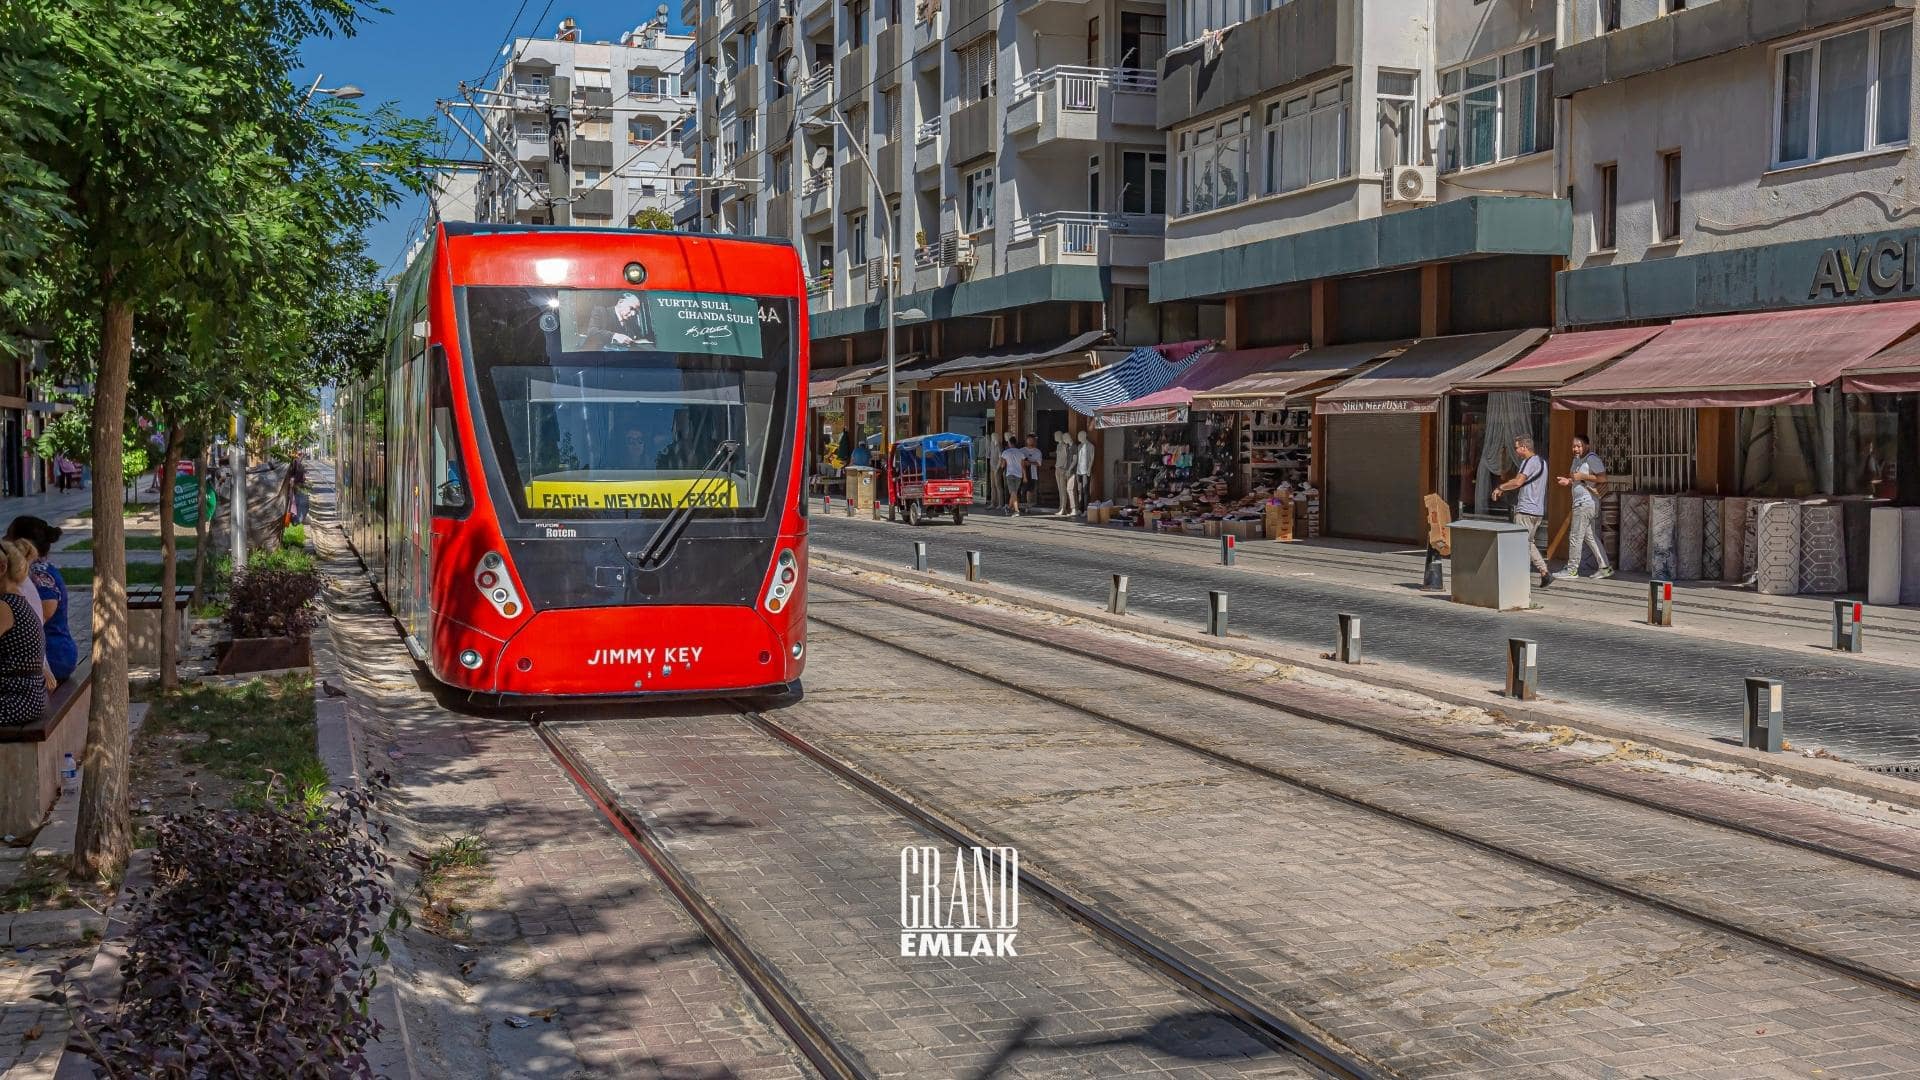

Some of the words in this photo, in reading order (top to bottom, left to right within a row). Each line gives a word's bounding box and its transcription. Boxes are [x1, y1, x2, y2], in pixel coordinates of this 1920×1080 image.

[657, 298, 700, 308] YURTTA
[701, 300, 732, 311] SULH,
[678, 308, 725, 321] CİHANDA
[727, 314, 754, 325] SULH
[954, 377, 1028, 403] HANGAR
[603, 493, 672, 508] MEYDAN
[546, 528, 577, 538] Rotem
[587, 648, 656, 665] JIMMY
[664, 646, 703, 662] KEY
